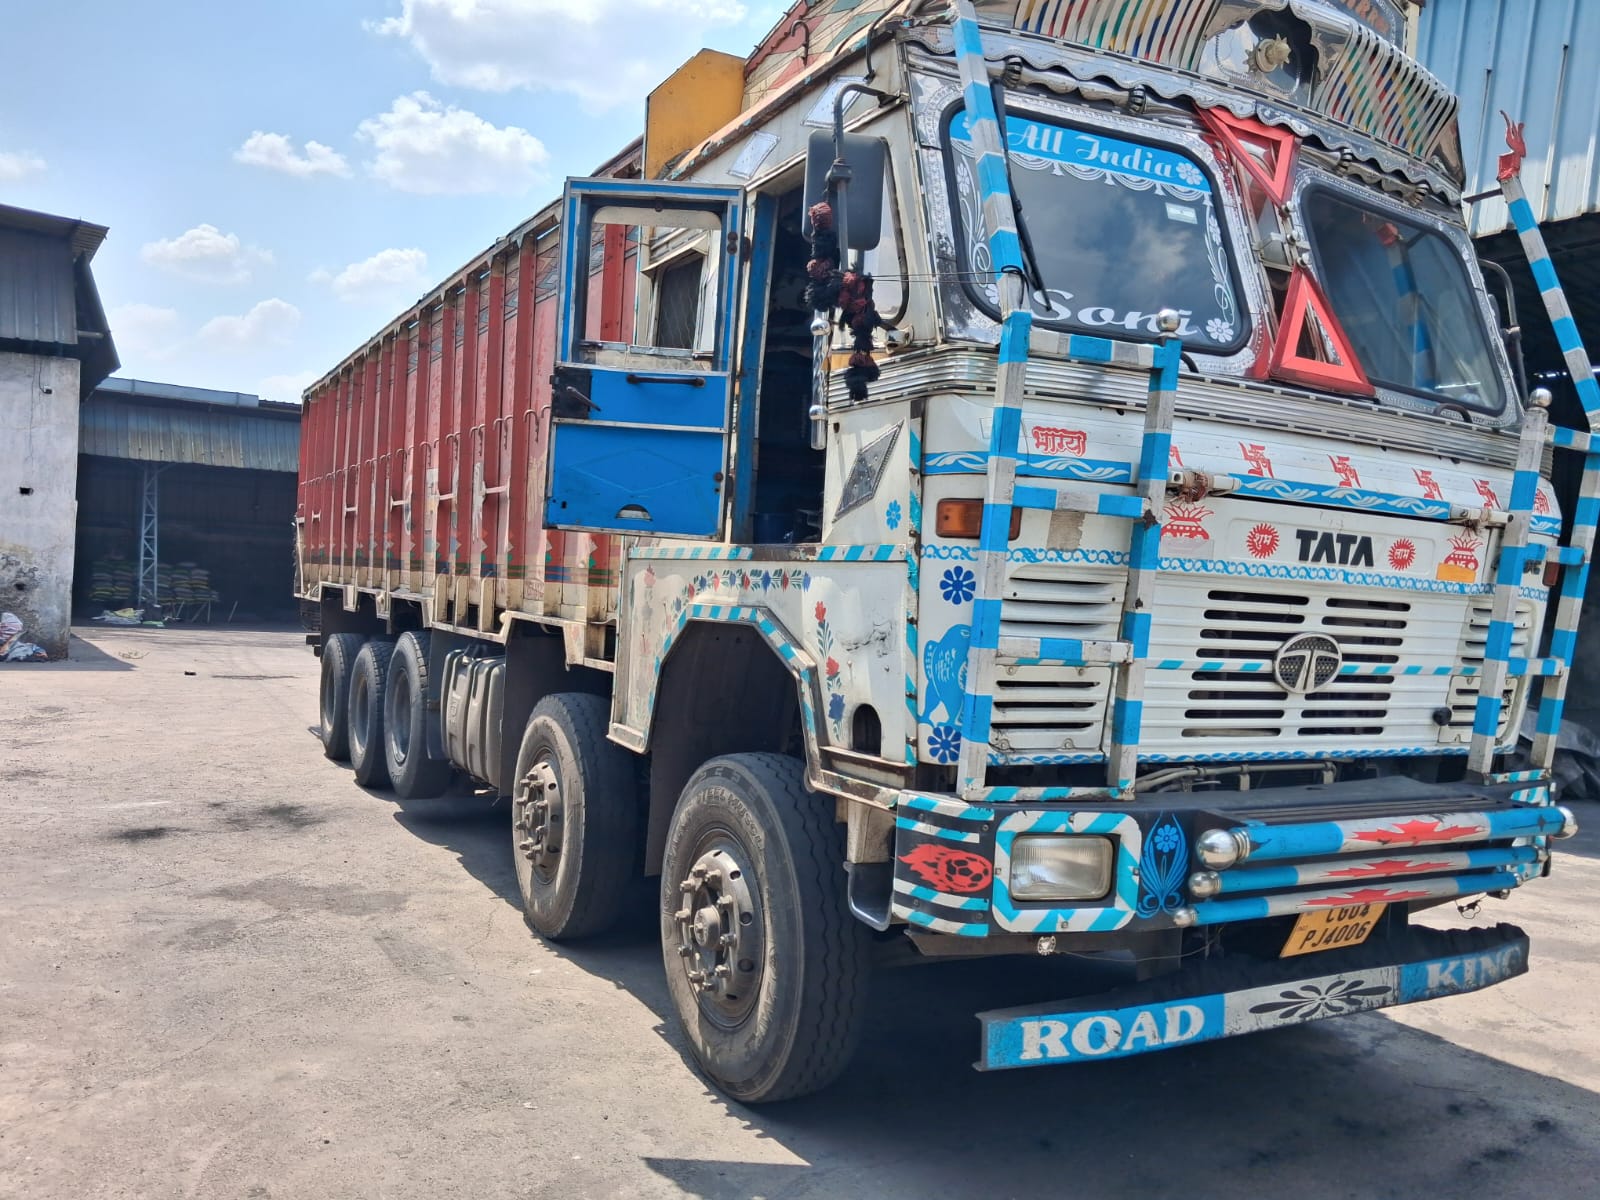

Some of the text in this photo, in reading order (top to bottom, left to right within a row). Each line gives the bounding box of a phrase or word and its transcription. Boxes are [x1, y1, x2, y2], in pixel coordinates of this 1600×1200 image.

[1007, 125, 1177, 179] All India
[1032, 426, 1087, 457] भाग्य
[1296, 529, 1374, 568] TATA
[1299, 920, 1371, 950] PJ4006
[1020, 1005, 1205, 1060] ROAD
